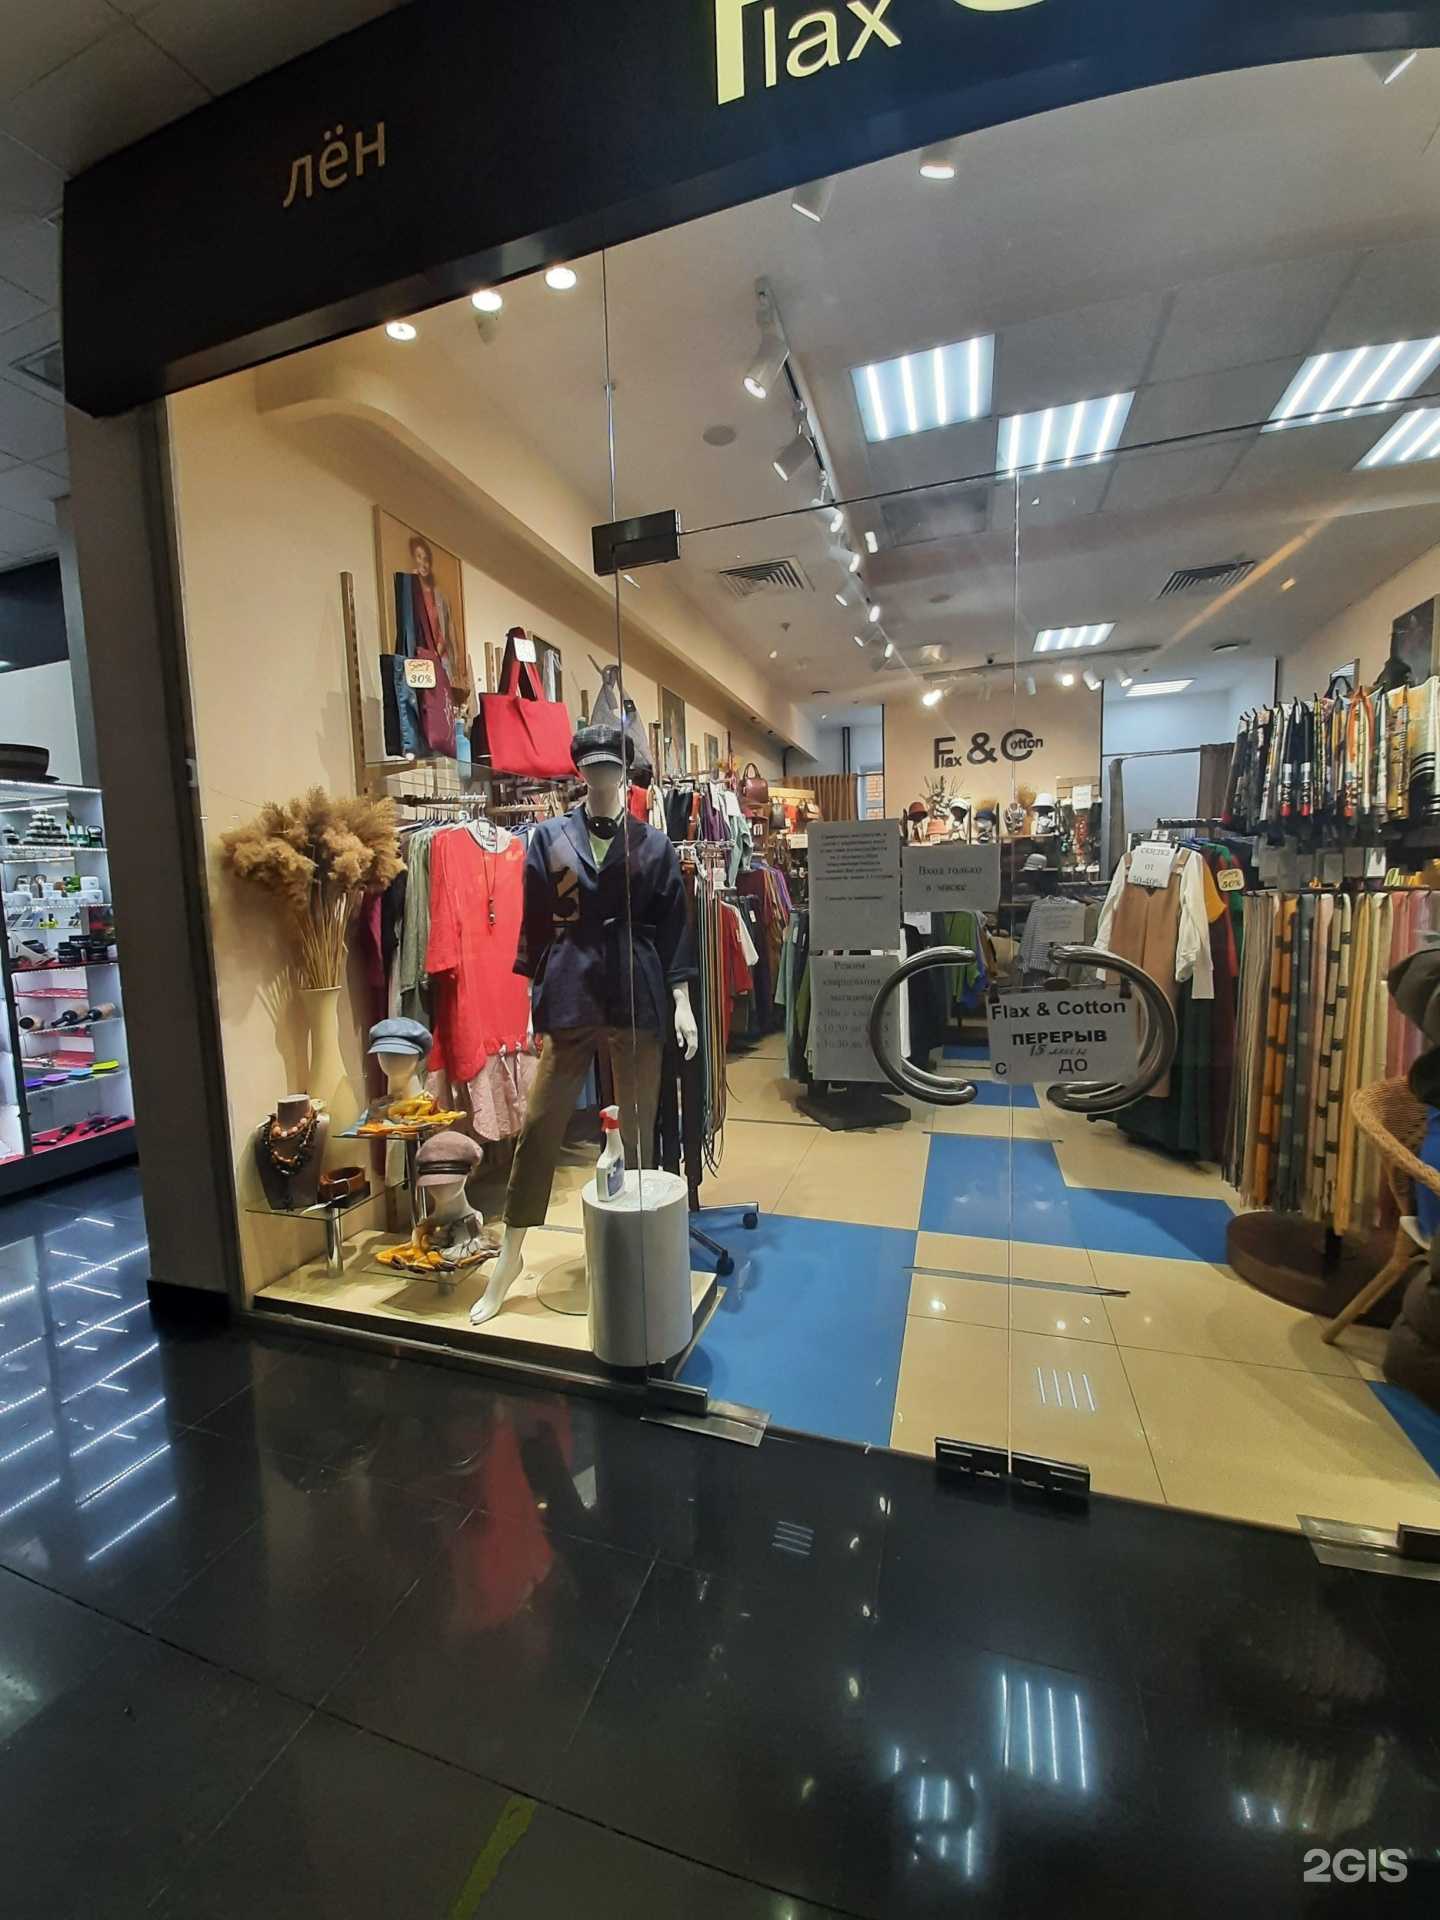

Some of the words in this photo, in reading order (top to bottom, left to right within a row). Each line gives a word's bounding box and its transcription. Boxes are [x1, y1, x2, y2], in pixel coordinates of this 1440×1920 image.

[283, 121, 385, 208] лён
[934, 736, 962, 768] Flax
[967, 732, 998, 765] &
[1001, 728, 1044, 762] Cotton
[991, 1005, 1030, 1020] Flax
[1036, 1002, 1050, 1017] &
[1057, 1001, 1126, 1016] Cotton
[1012, 1030, 1107, 1046] ПЕРЕРЫВ
[1058, 1058, 1088, 1075] ДО
